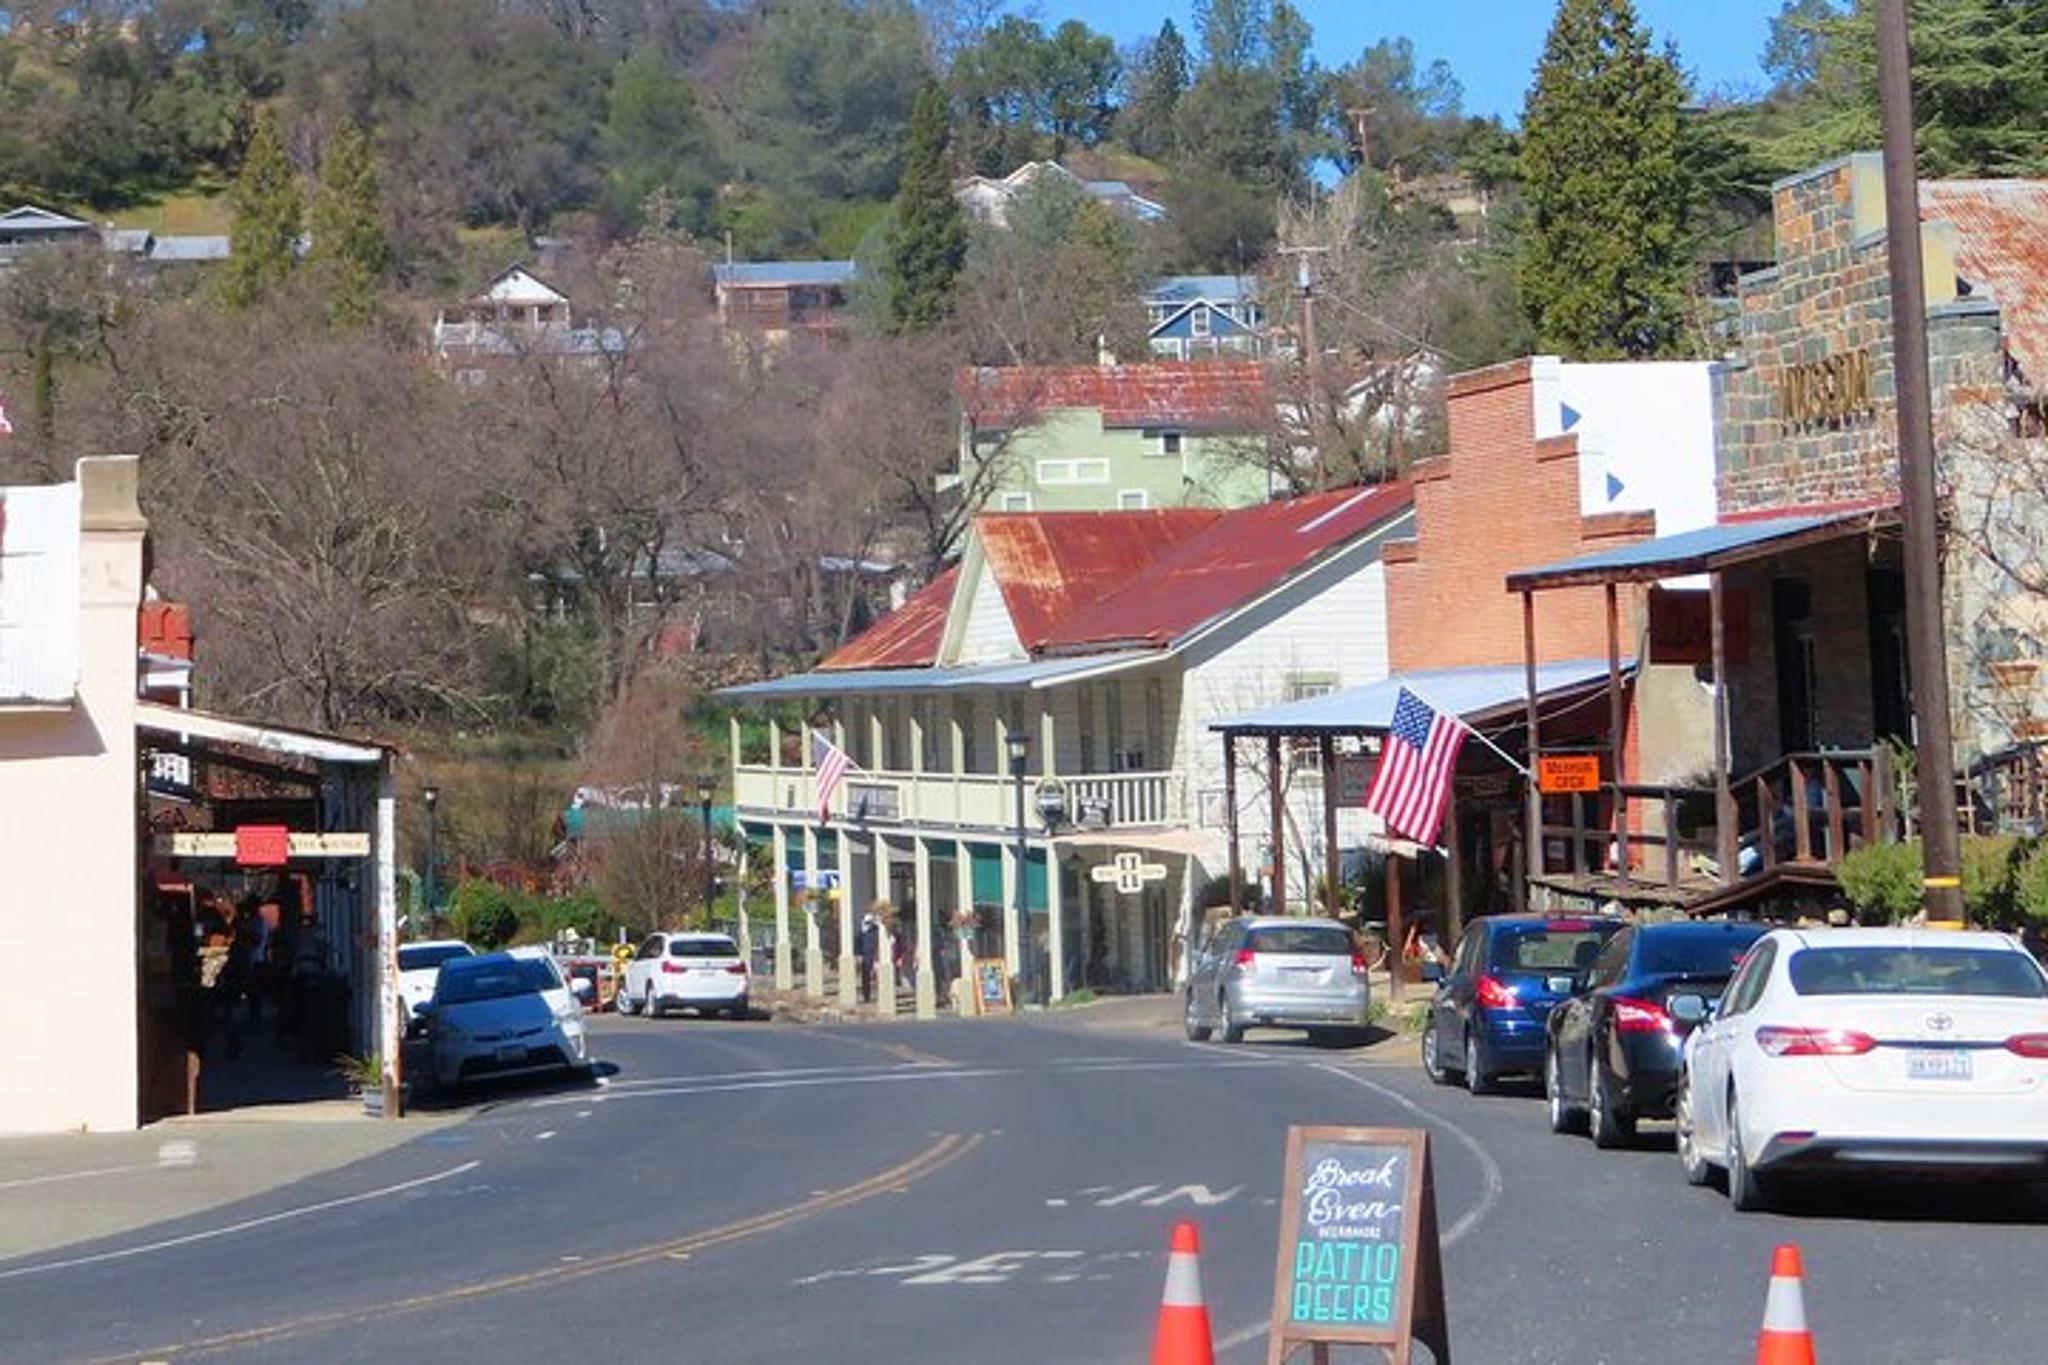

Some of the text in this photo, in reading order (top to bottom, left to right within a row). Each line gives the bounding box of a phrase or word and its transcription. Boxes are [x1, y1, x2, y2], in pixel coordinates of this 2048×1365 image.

[1303, 1156, 1398, 1195] Break
[1307, 1187, 1402, 1226] Even
[1295, 1241, 1399, 1283] PATIO
[1293, 1283, 1391, 1322] BEERS
